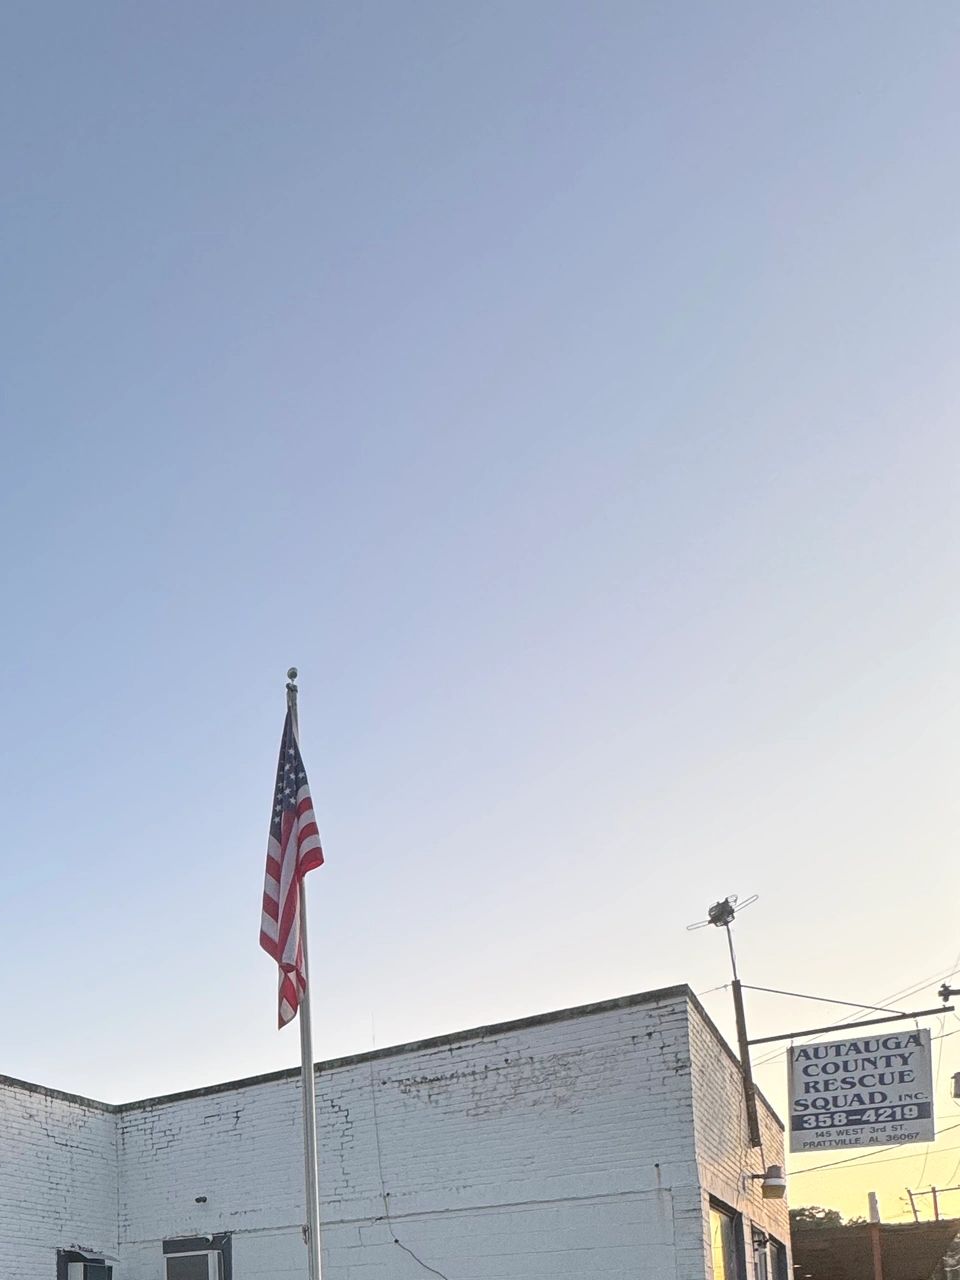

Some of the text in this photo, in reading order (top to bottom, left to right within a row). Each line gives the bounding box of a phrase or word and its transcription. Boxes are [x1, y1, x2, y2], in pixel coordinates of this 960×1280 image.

[795, 1034, 924, 1062] AUTAUGA
[802, 1052, 915, 1077] COUNTY
[803, 1070, 915, 1094] RESCUE
[898, 1092, 929, 1102] INC.
[803, 1105, 919, 1128] 358-4219
[815, 1130, 832, 1138] 145
[836, 1128, 865, 1137] WEST
[869, 1125, 887, 1134] 3rd
[886, 1132, 920, 1142] 36067
